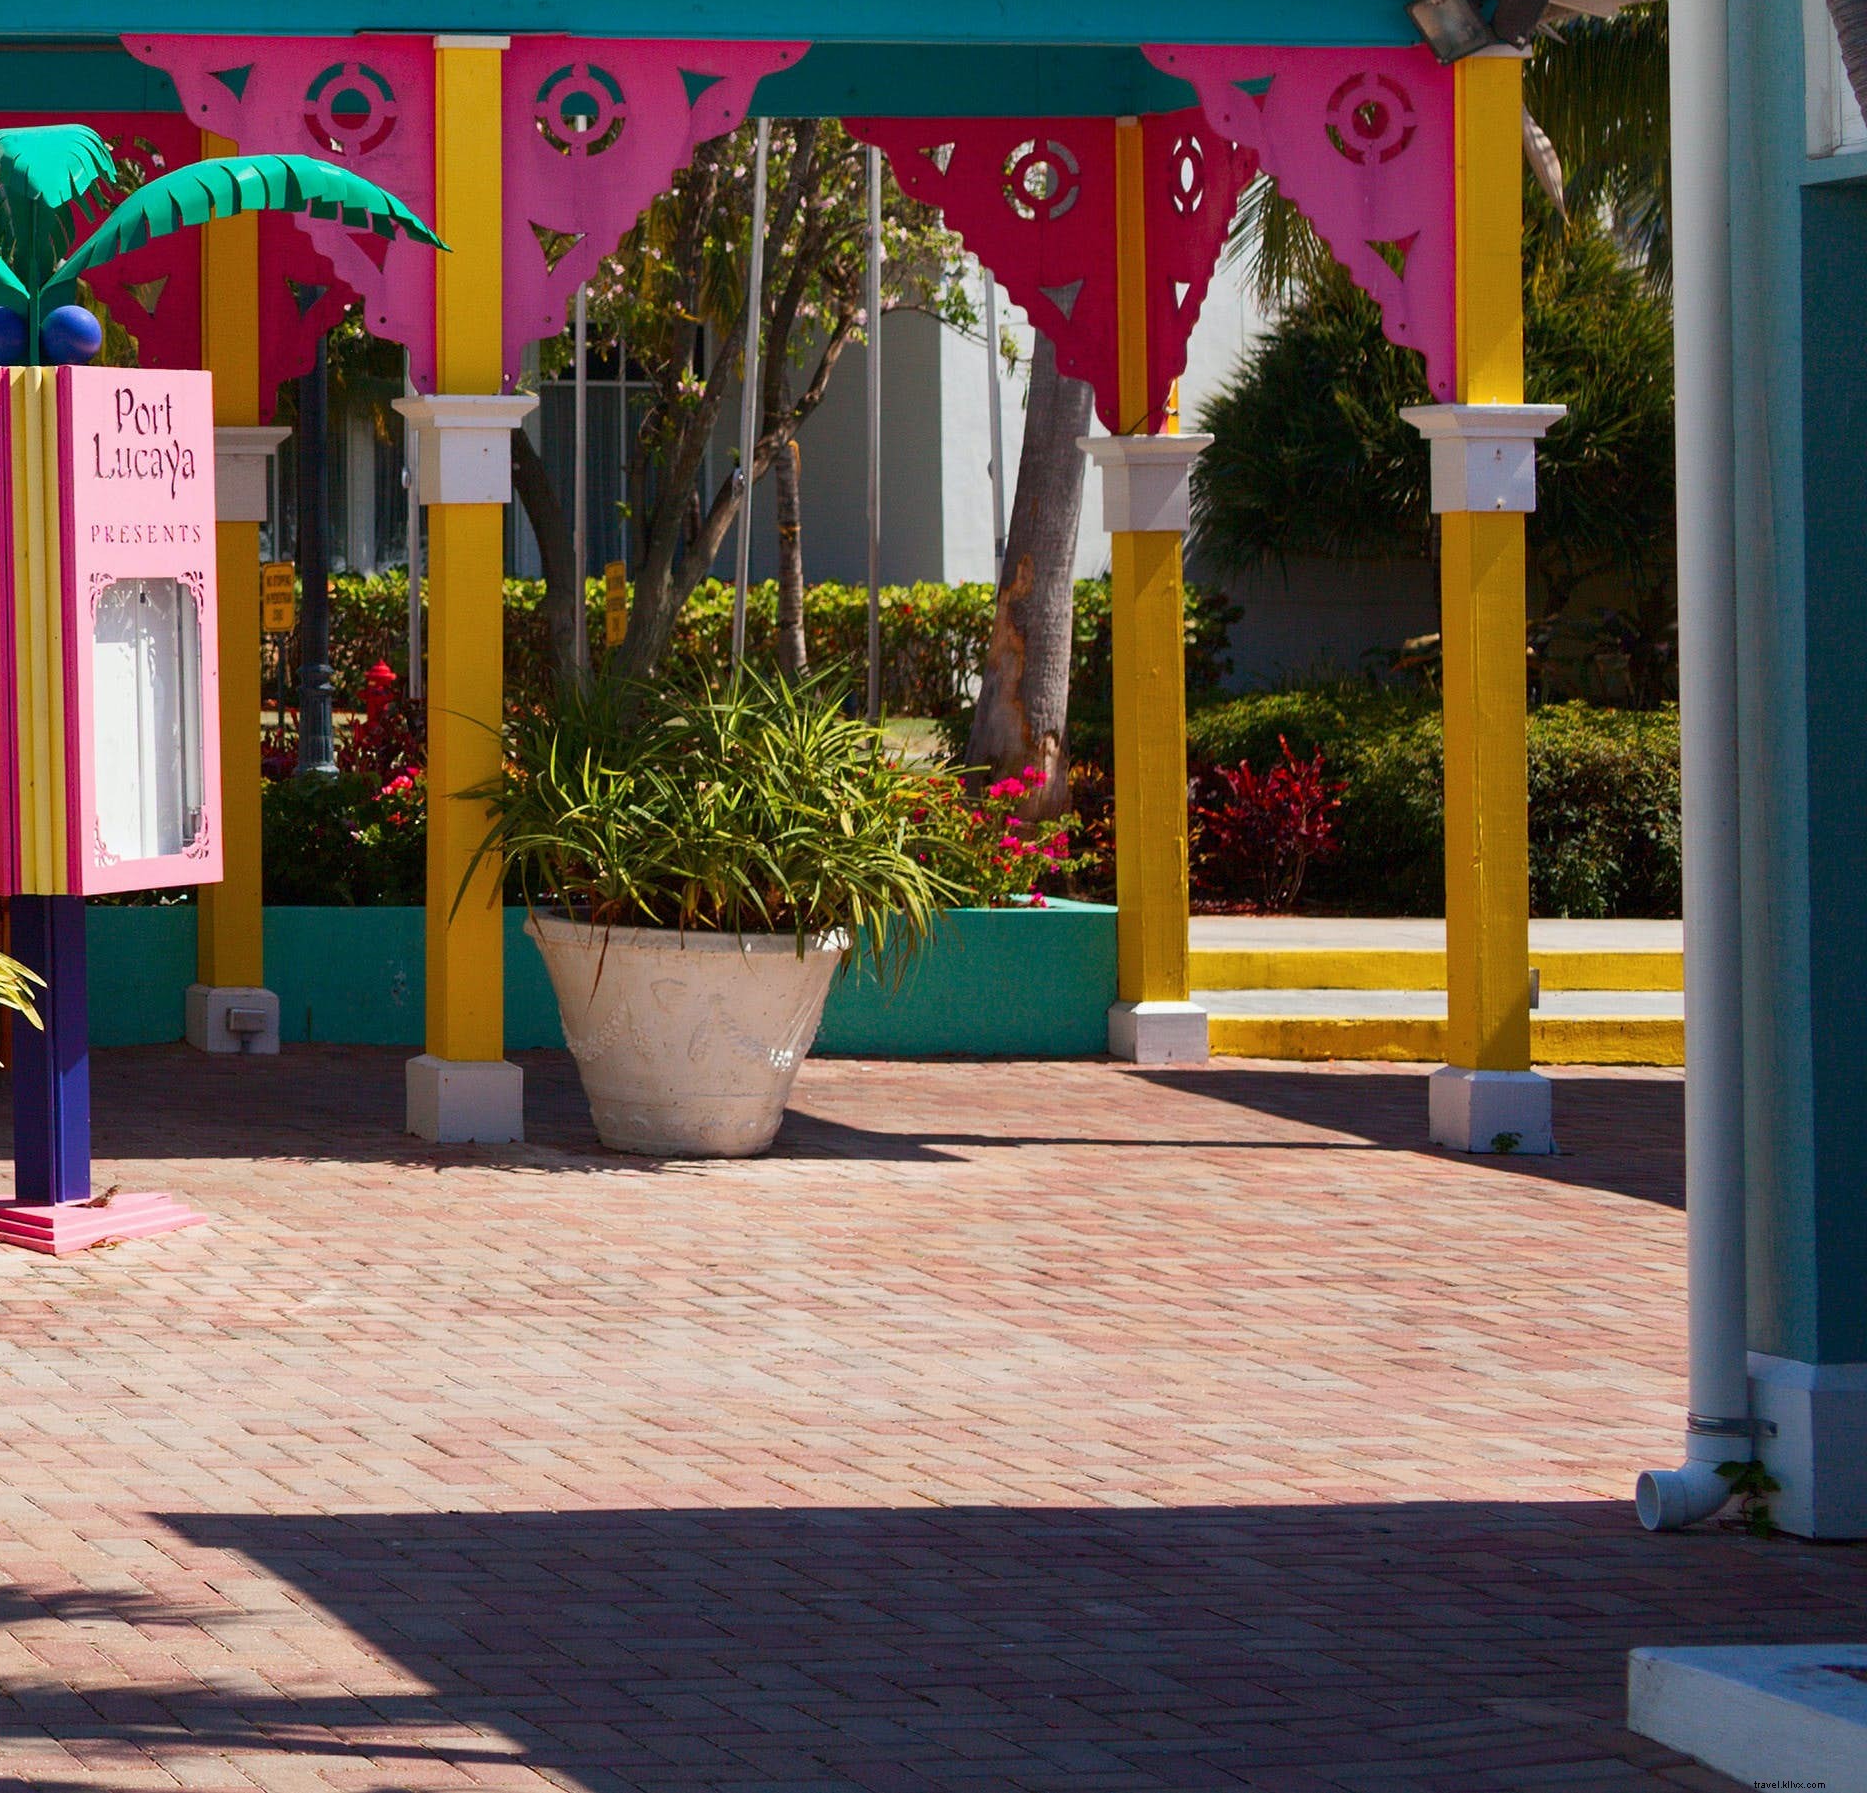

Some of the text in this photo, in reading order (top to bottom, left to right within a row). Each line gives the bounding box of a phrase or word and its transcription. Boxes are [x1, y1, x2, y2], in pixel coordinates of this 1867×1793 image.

[115, 388, 173, 436] Port
[93, 433, 195, 500] Lucaya
[90, 524, 201, 544] PRESENTS
